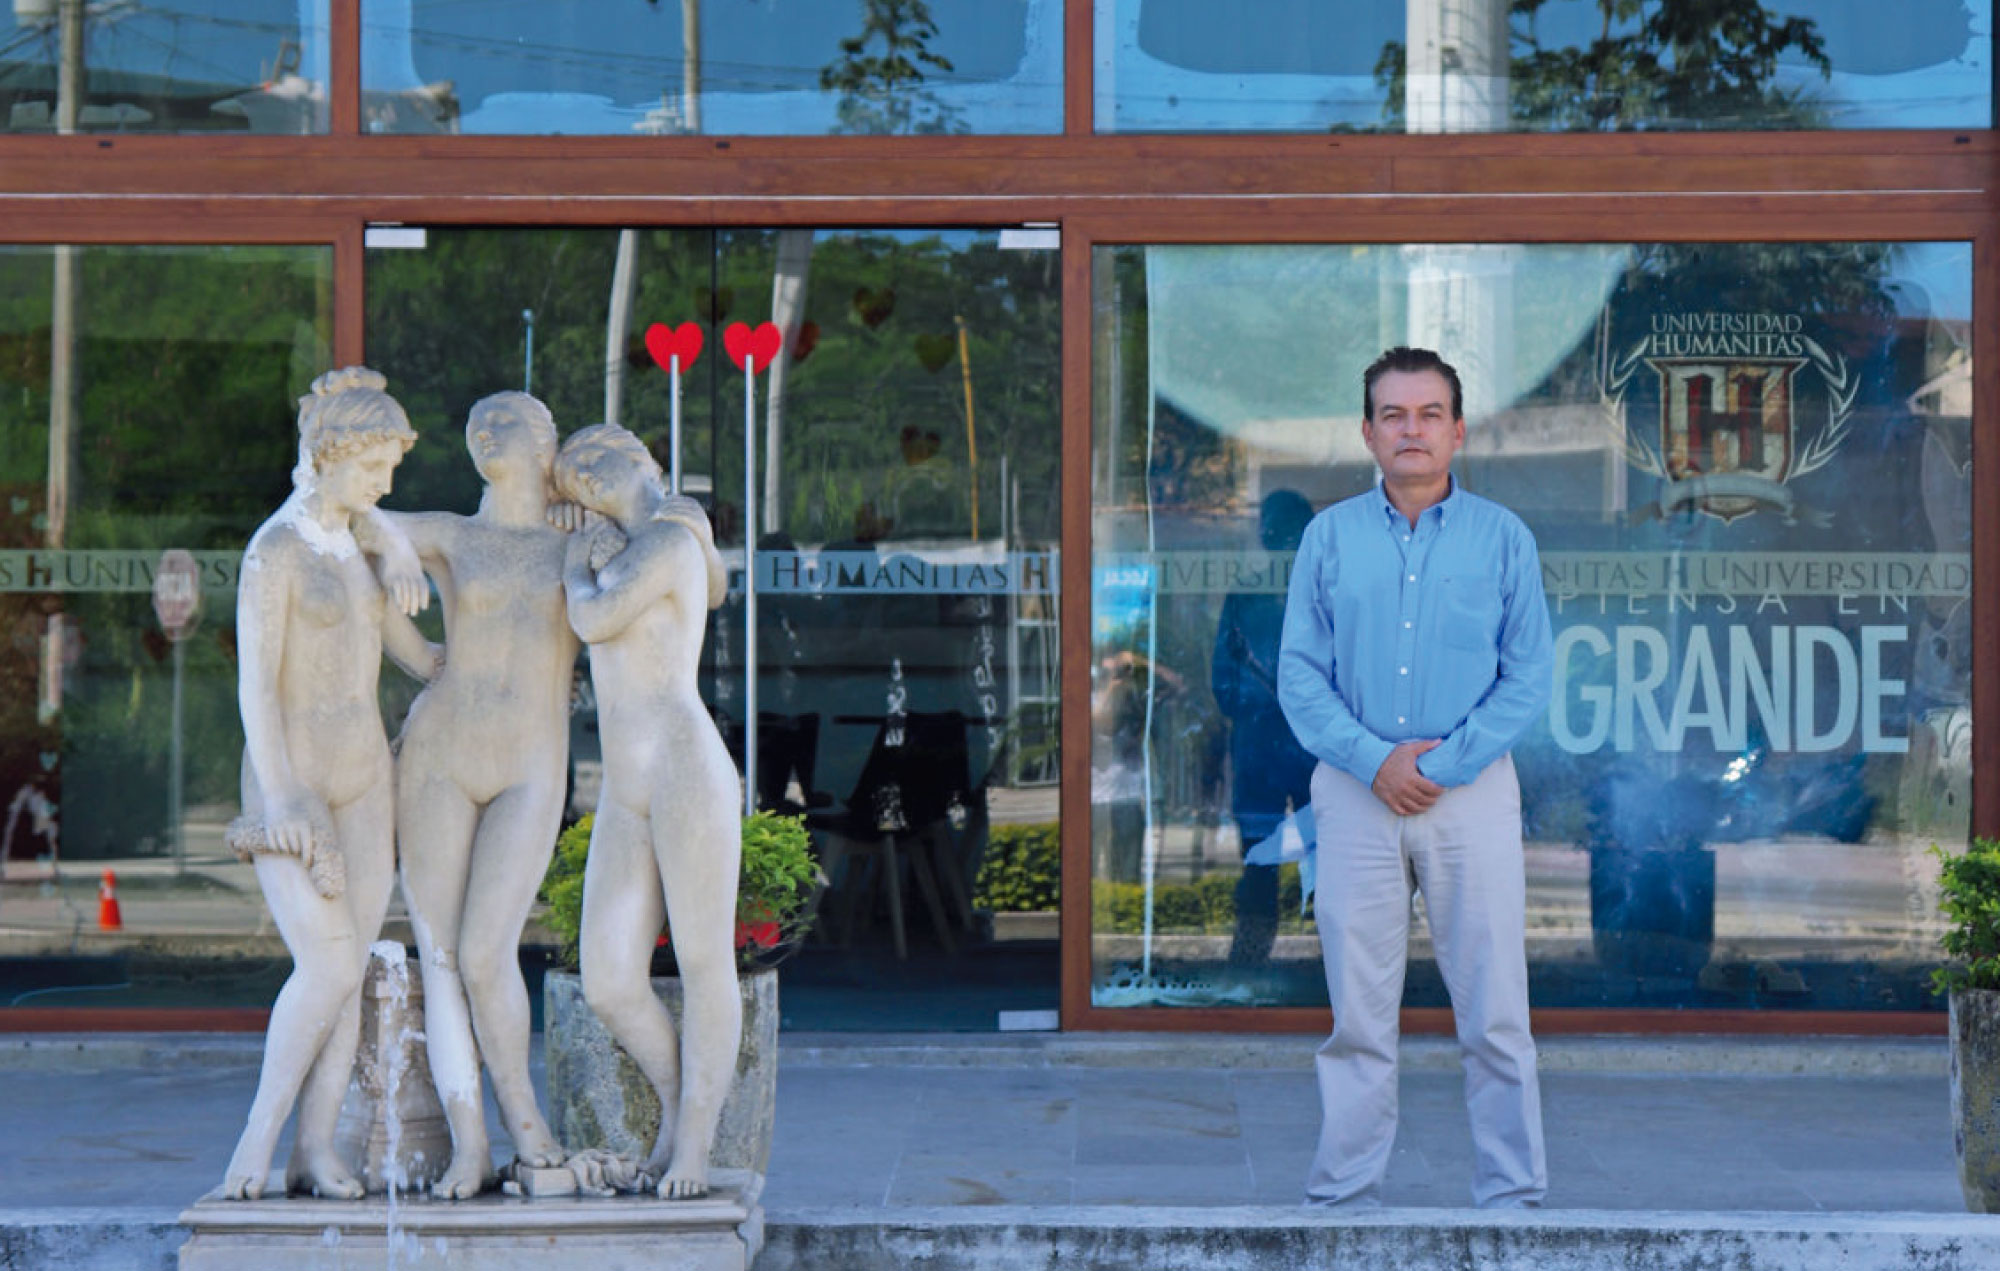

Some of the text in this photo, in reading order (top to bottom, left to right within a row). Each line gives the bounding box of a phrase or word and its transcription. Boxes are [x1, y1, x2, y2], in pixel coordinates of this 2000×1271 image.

[1652, 313, 1802, 333] UNIVERSIDAD
[1651, 334, 1803, 355] HUMANITAS
[771, 555, 1010, 588] HUMANITAS
[1701, 556, 1969, 591] UNIVERSIDAD
[1556, 579, 1909, 615] PIENSA EN
[1548, 625, 1909, 755] GRANDE
